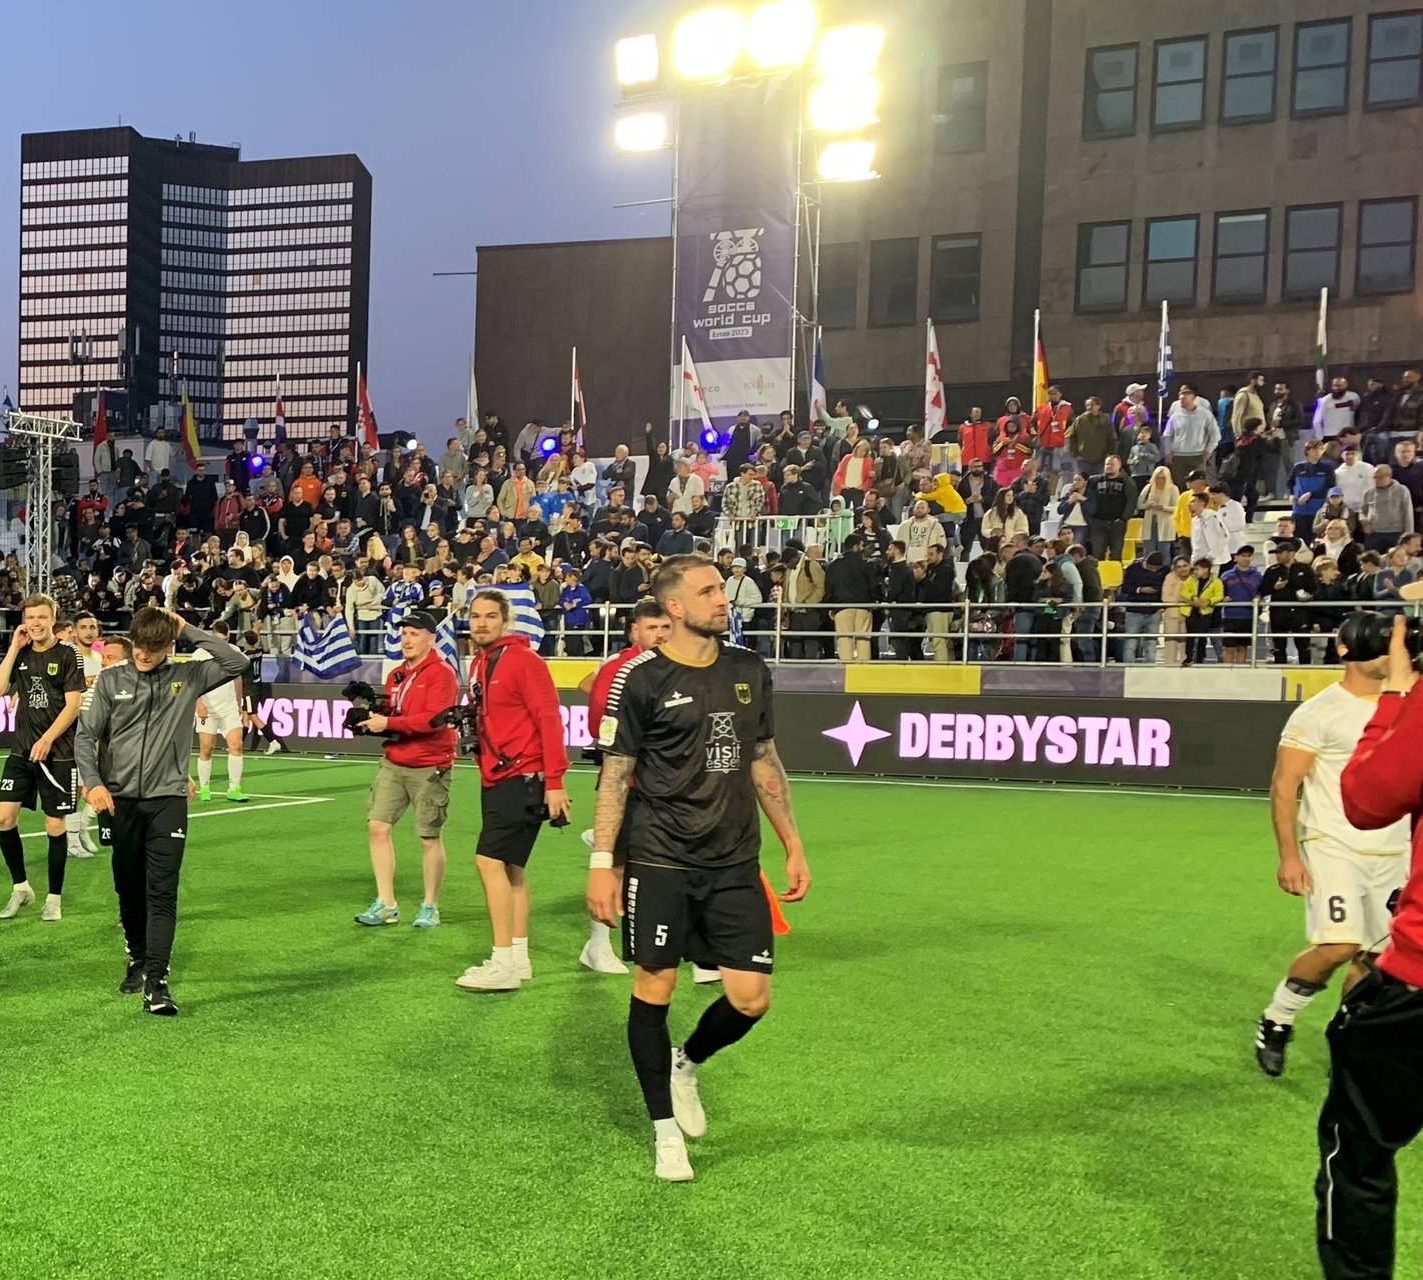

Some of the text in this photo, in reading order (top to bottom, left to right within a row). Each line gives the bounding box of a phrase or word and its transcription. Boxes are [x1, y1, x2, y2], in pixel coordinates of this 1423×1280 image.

[708, 302, 755, 314] socca
[693, 313, 770, 328] world cup
[899, 712, 1171, 767] DERBYSTAR
[705, 742, 741, 760] visit
[0, 779, 14, 791] 23
[1328, 896, 1346, 923] 6
[654, 924, 668, 946] 5
